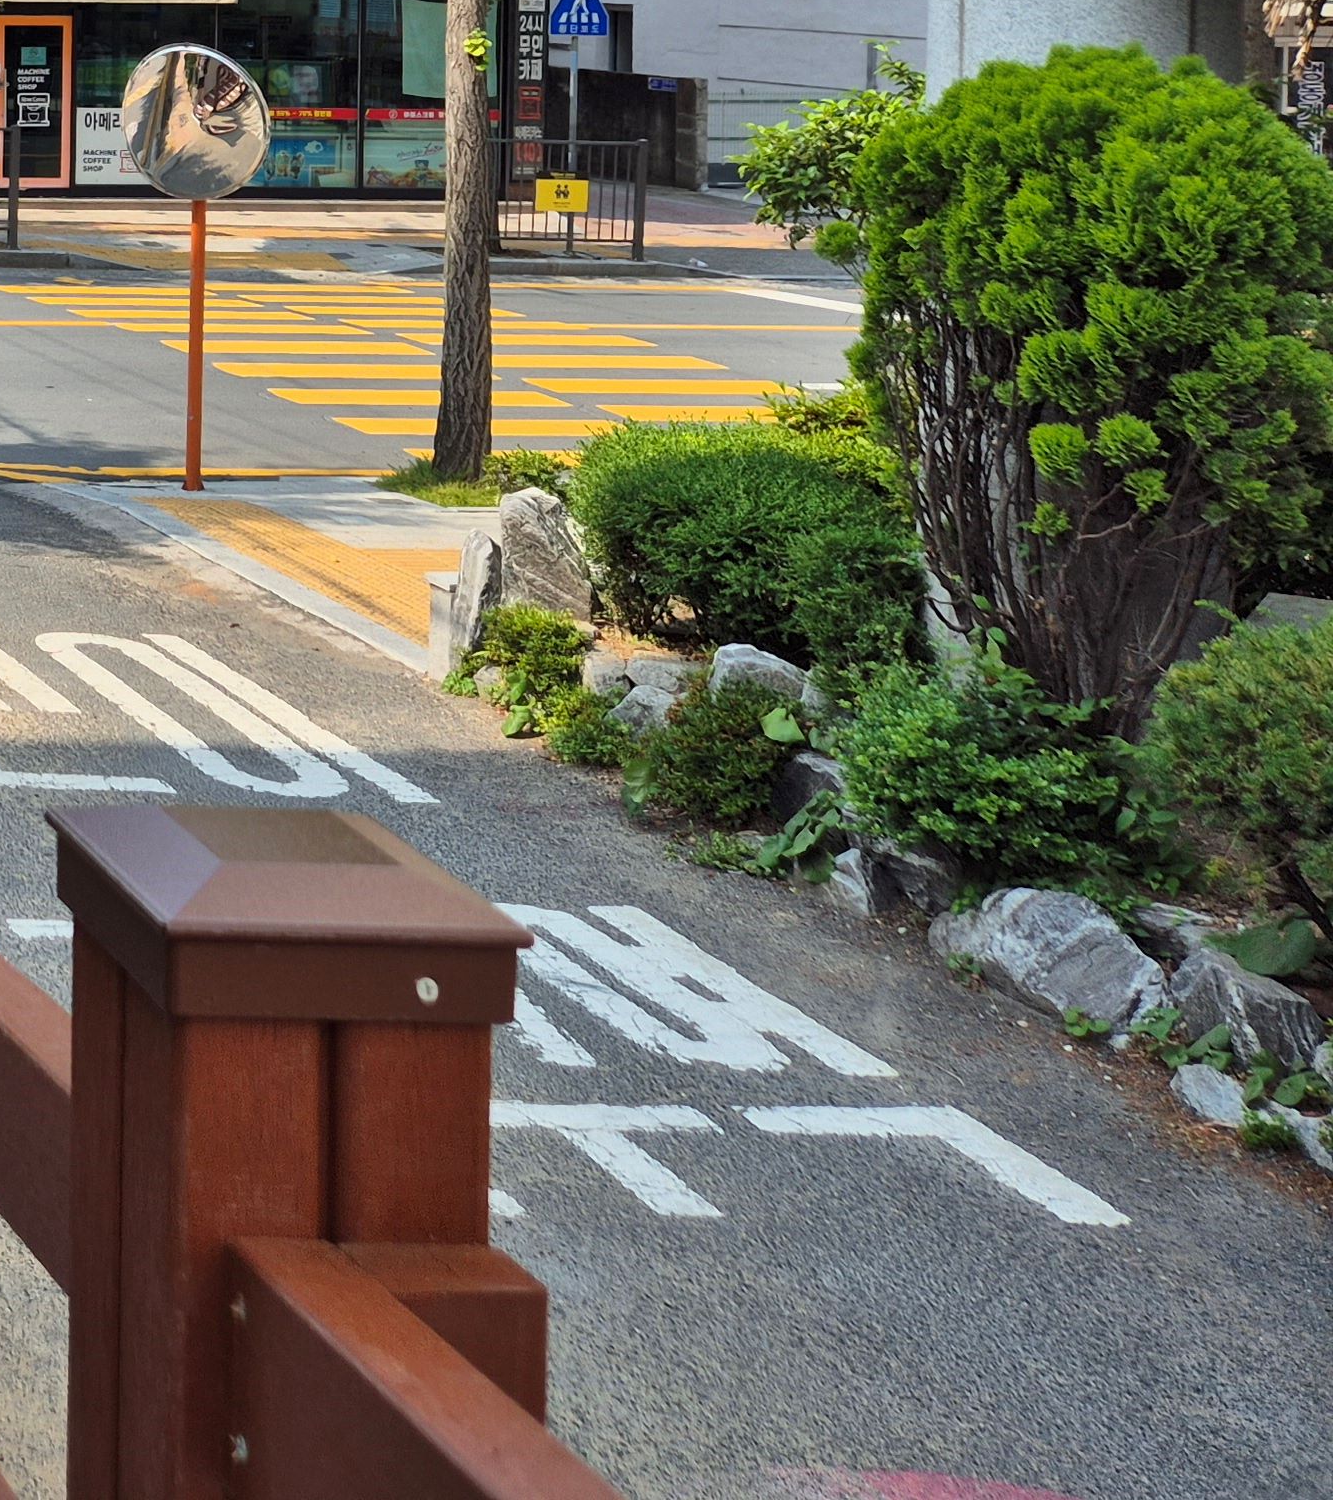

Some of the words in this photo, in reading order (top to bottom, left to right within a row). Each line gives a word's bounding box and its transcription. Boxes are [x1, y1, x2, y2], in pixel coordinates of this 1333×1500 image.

[519, 15, 544, 32] 24시
[519, 36, 544, 56] 무인
[518, 58, 543, 81] 카페
